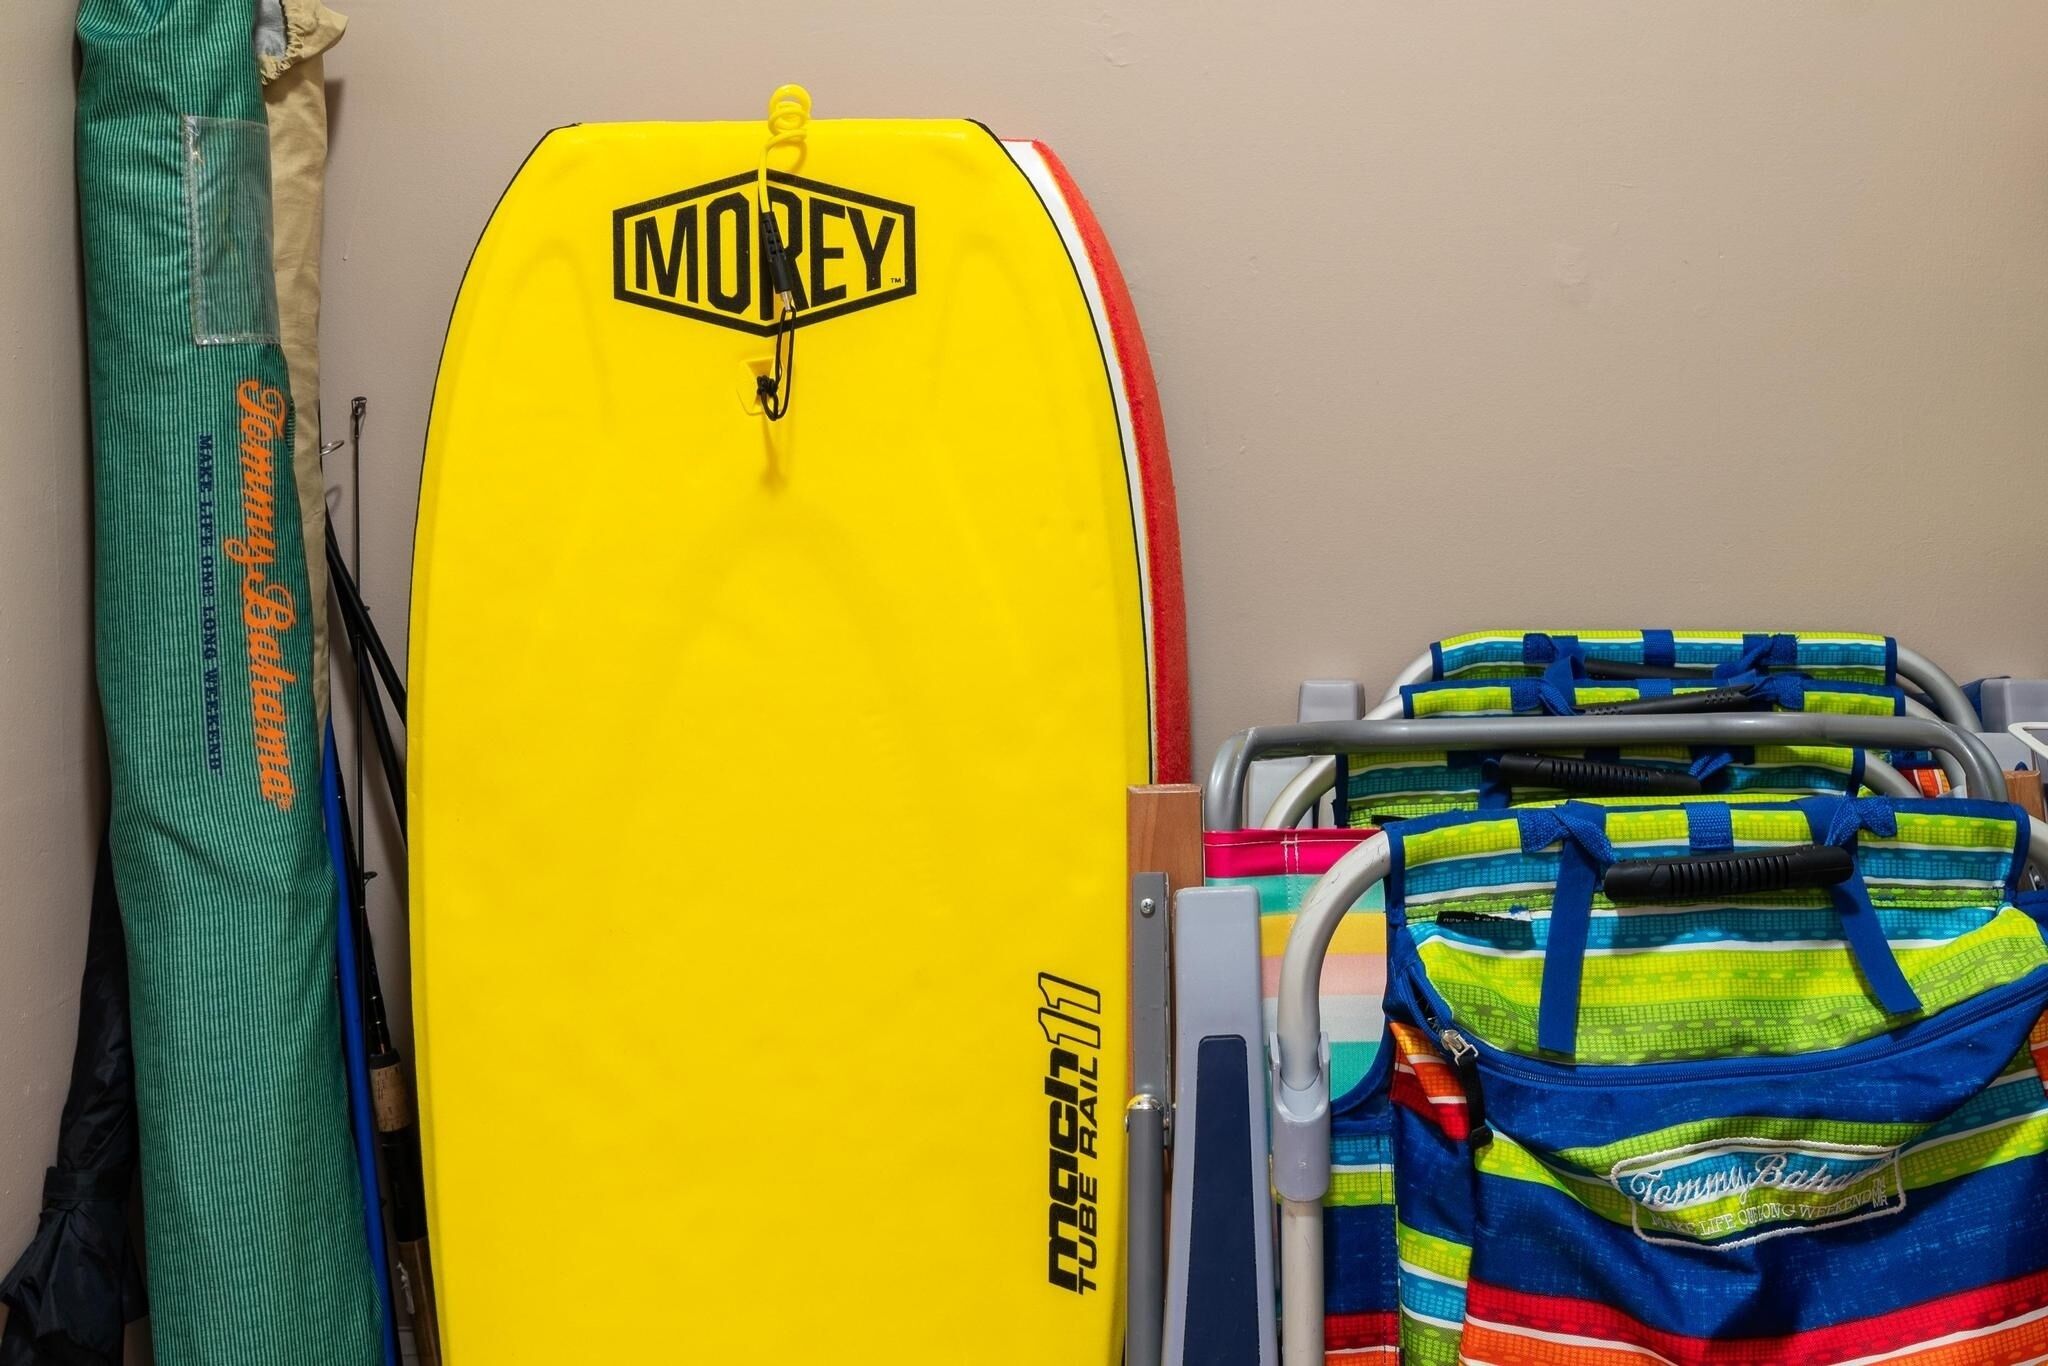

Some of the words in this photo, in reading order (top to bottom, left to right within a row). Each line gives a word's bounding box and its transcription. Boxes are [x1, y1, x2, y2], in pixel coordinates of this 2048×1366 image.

[635, 185, 896, 321] MOREY
[200, 434, 213, 492] MAKE
[224, 380, 286, 565] Tommy
[201, 501, 214, 547] LIFE
[203, 556, 215, 597] ONE
[204, 606, 217, 660] LONG
[205, 668, 222, 772] WEEKEND
[1079, 1056, 1099, 1160] RAIL
[1630, 1165, 1752, 1204] Tommy
[1078, 1171, 1098, 1296] TUBE
[1699, 1212, 1736, 1236] LIFE
